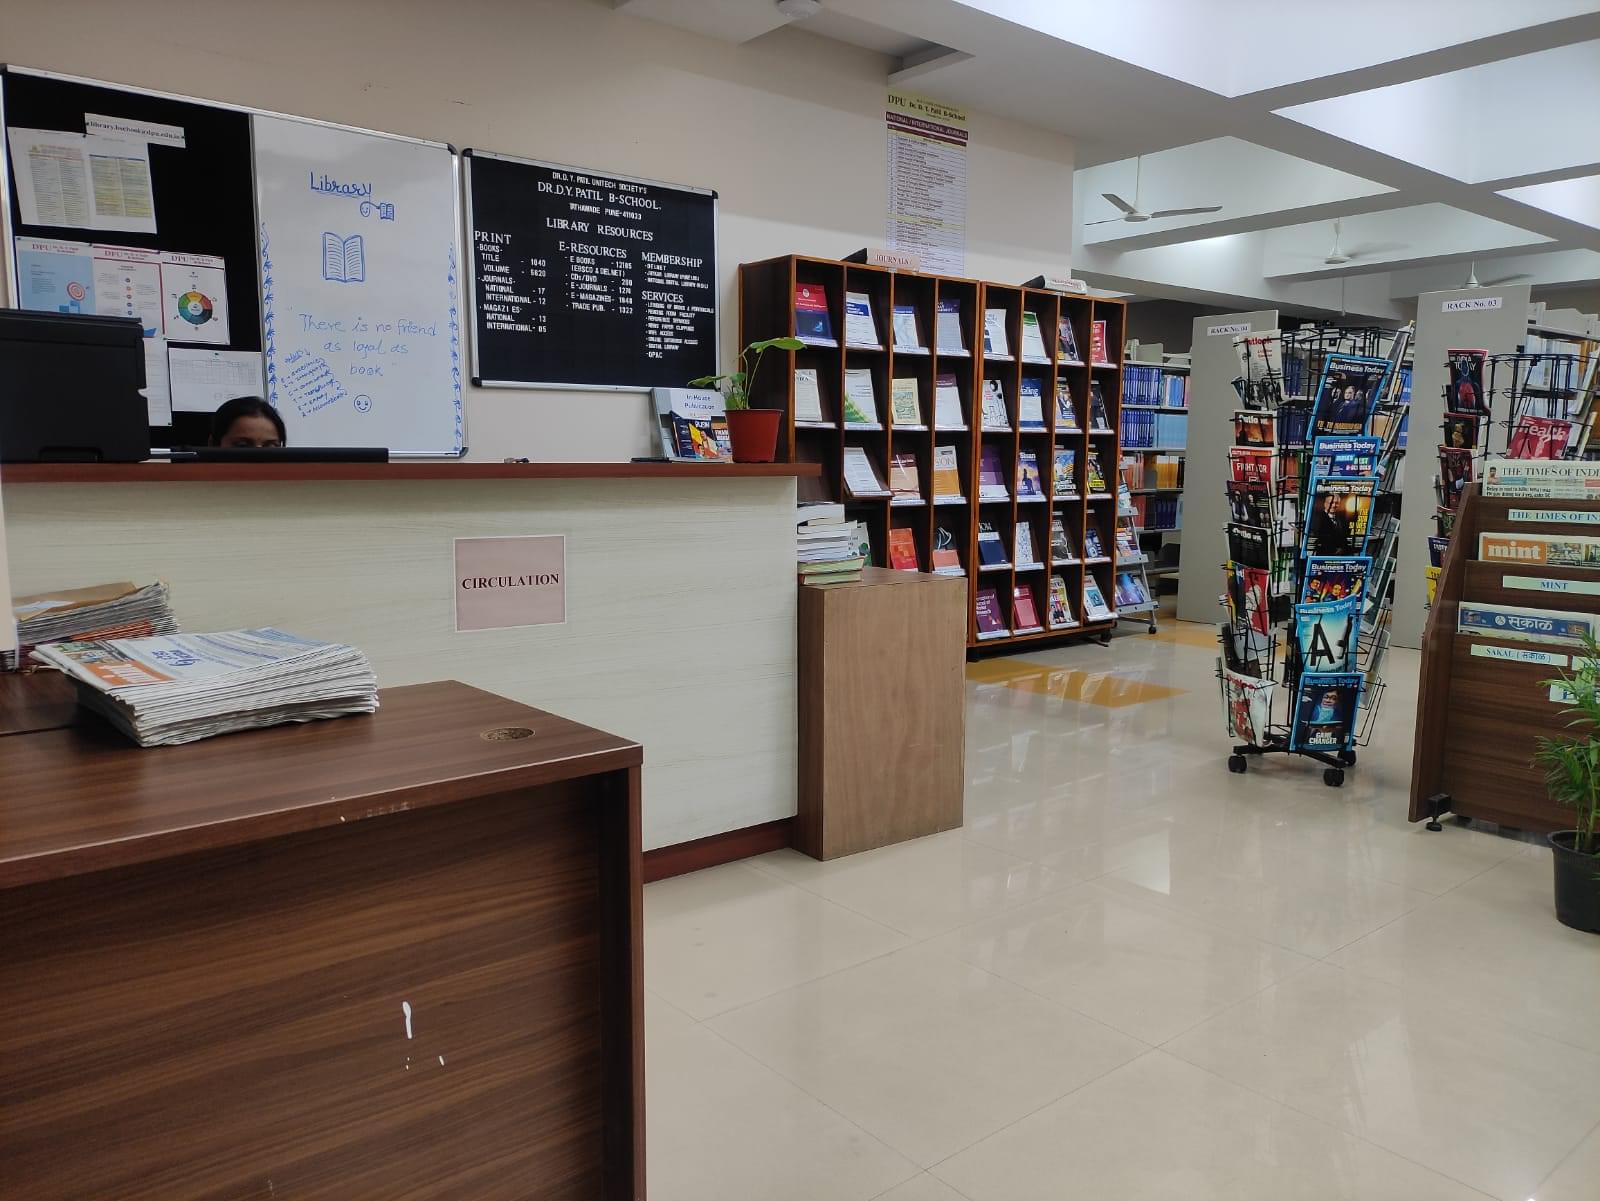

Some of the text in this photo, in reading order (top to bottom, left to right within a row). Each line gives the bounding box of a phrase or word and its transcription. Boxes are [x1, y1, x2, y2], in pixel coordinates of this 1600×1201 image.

[888, 94, 906, 107] DPU
[309, 171, 372, 197] Library
[592, 178, 616, 189] UNITECH
[546, 217, 653, 241] LIBRARY RESOURCES
[474, 230, 512, 244] PRINT
[559, 241, 627, 259] E-RESOURCES
[481, 252, 500, 262] TITLE
[641, 251, 703, 268] MEMBERSHIP
[483, 264, 510, 274] VOLUME
[485, 284, 514, 294] NATIONAL
[485, 293, 532, 304] INTERNATIONAL
[641, 290, 684, 304] SERVICES
[1447, 300, 1471, 310] RACK
[1473, 300, 1486, 309] No.
[299, 313, 438, 337] There is no friend
[486, 321, 533, 332] INTERNATIONAL
[352, 340, 386, 359] loyal
[350, 362, 383, 377] book
[1330, 361, 1385, 374] Business Today
[1319, 442, 1376, 450] Business Today
[1236, 462, 1254, 472] FIHT
[1503, 467, 1600, 478] THE TIMES OF INDI
[1316, 484, 1373, 492] Business Today
[1512, 511, 1600, 522] THE TIMES OF IN
[1487, 540, 1541, 560] mint
[1311, 563, 1367, 572] Business Today
[462, 573, 559, 590] CIRCULATION
[1540, 581, 1569, 590] MINT
[1508, 615, 1553, 631] सकाळ
[1486, 648, 1514, 657] SAKAL
[1304, 677, 1359, 685] Business Today
